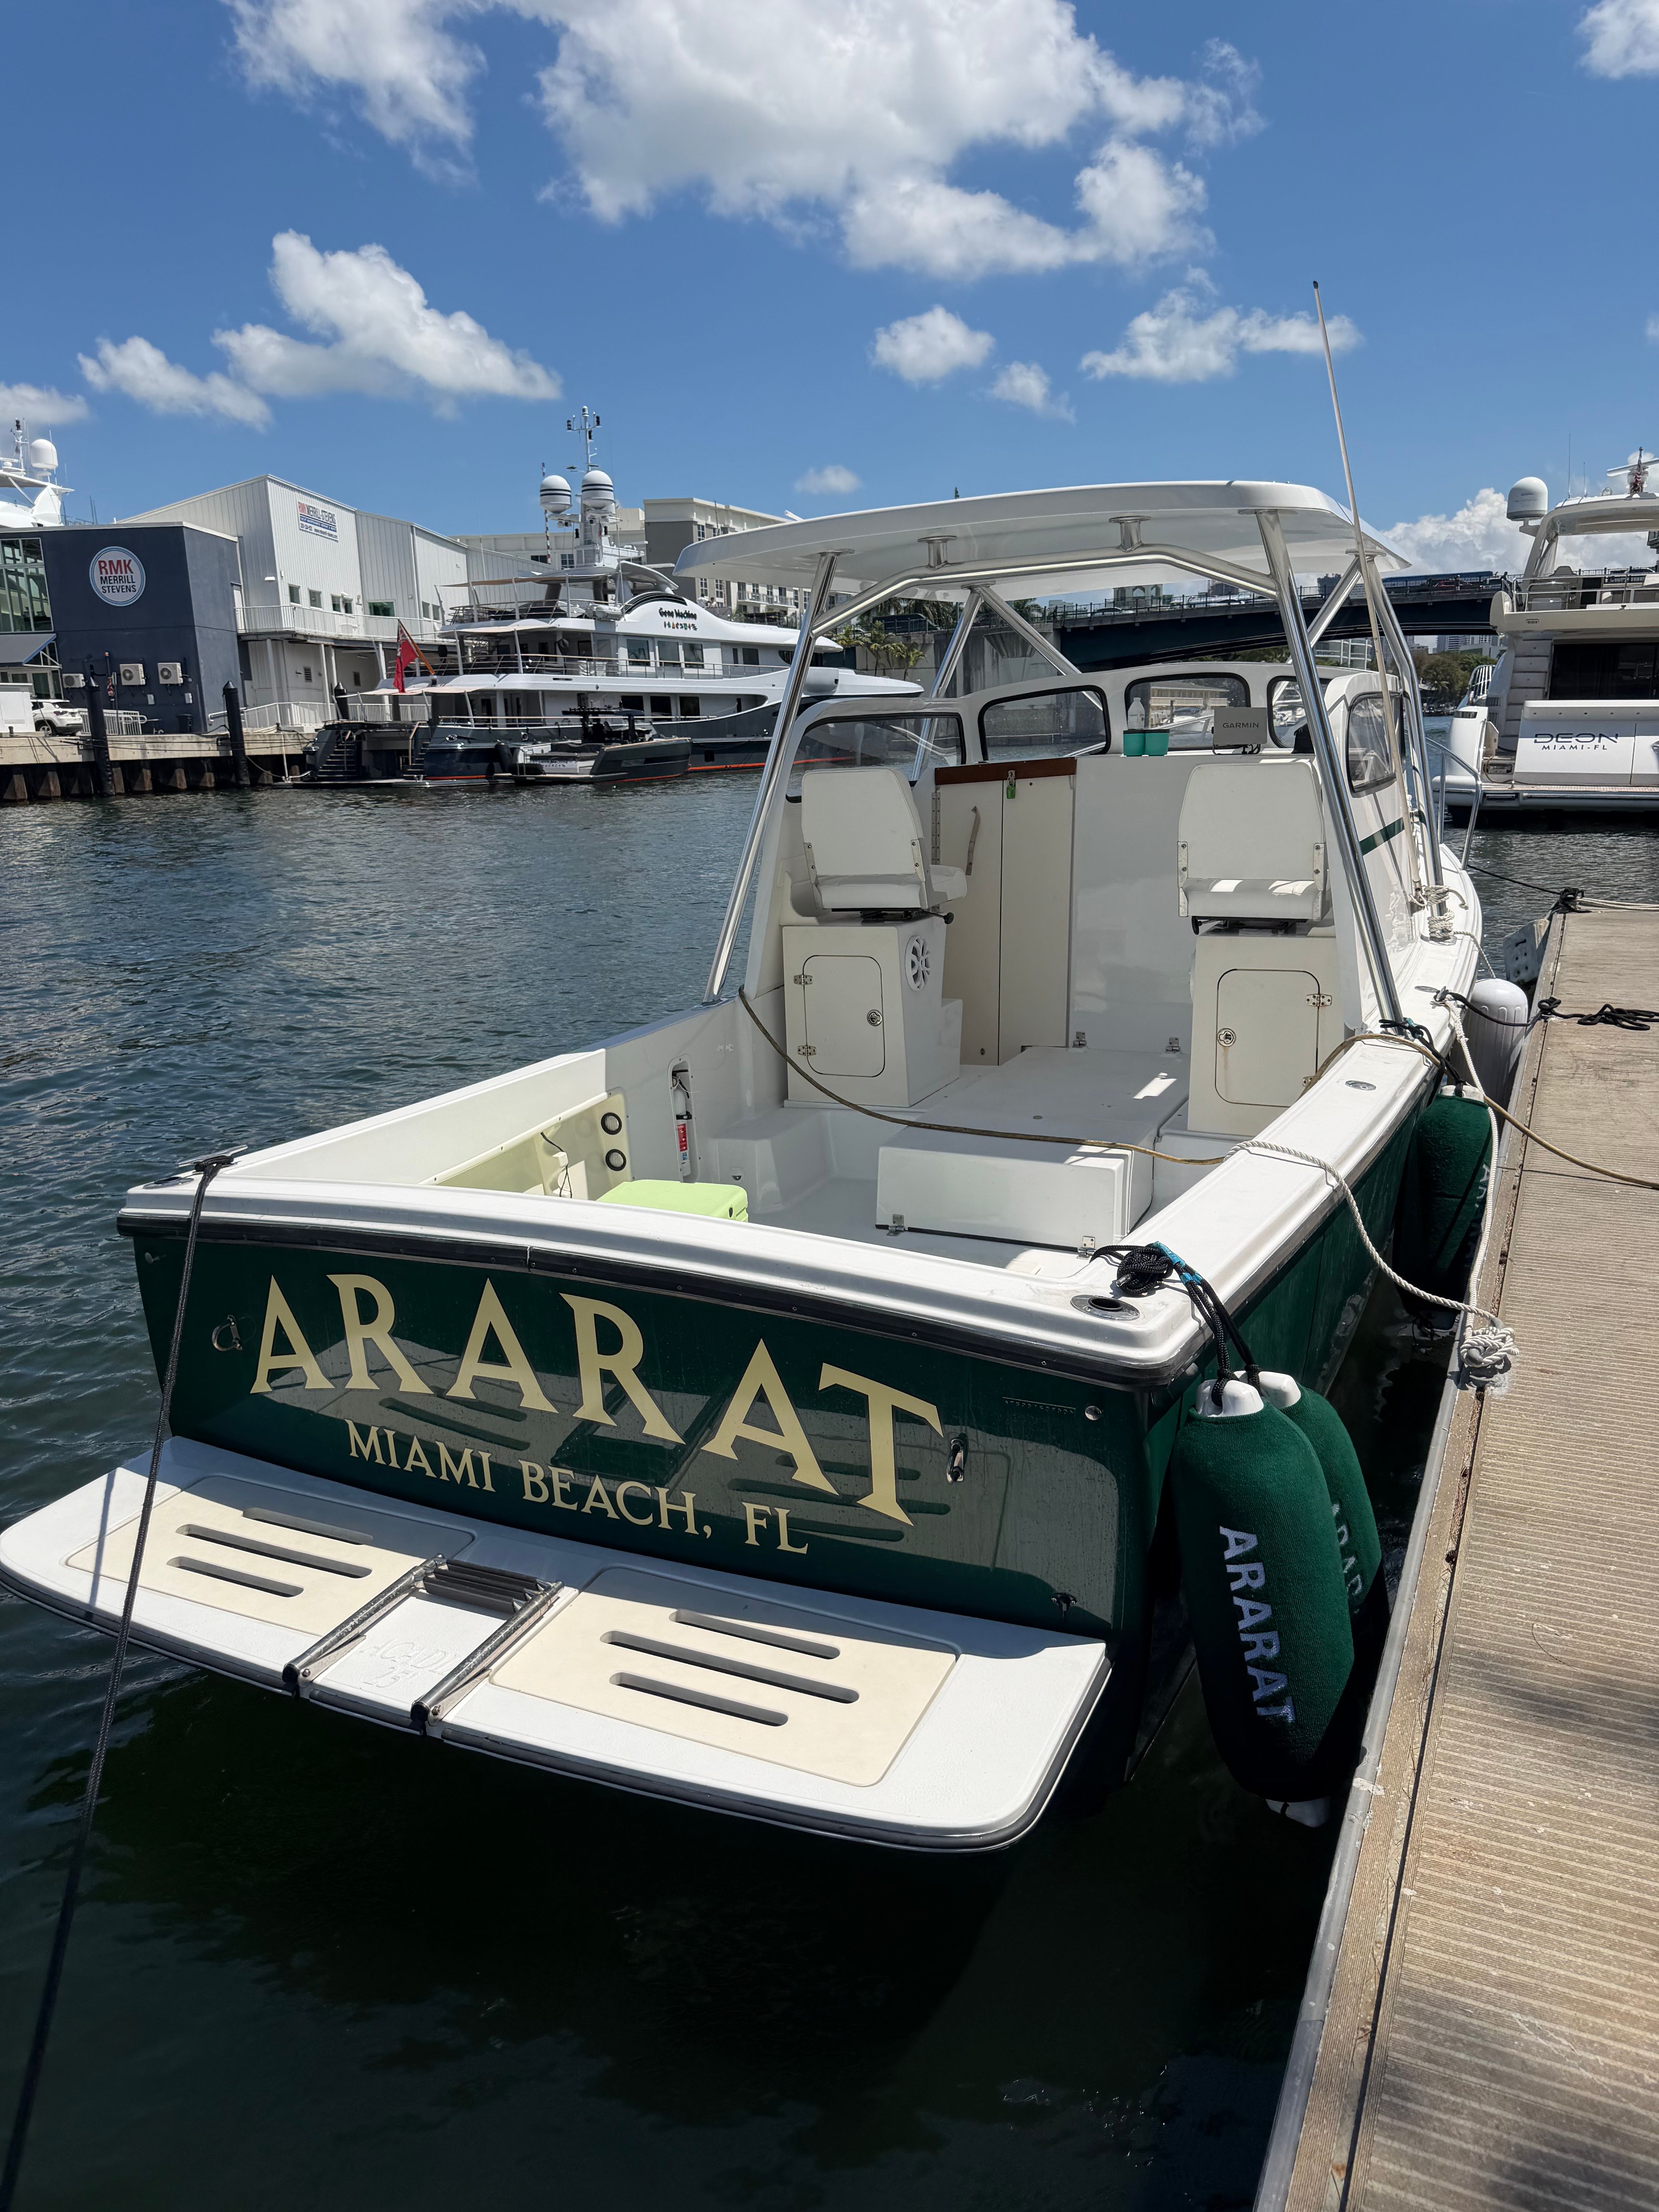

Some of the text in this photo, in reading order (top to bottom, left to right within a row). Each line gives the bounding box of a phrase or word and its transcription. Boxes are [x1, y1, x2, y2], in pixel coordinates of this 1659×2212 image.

[98, 559, 134, 575] RMK
[100, 575, 136, 585] MERRILL
[101, 585, 137, 594] STEVENS
[1534, 733, 1619, 743] DEON
[250, 1274, 944, 1526] ARARAT
[346, 1420, 809, 1555] MIAMI BEACH, FL
[1219, 1525, 1296, 1723] ARARAT
